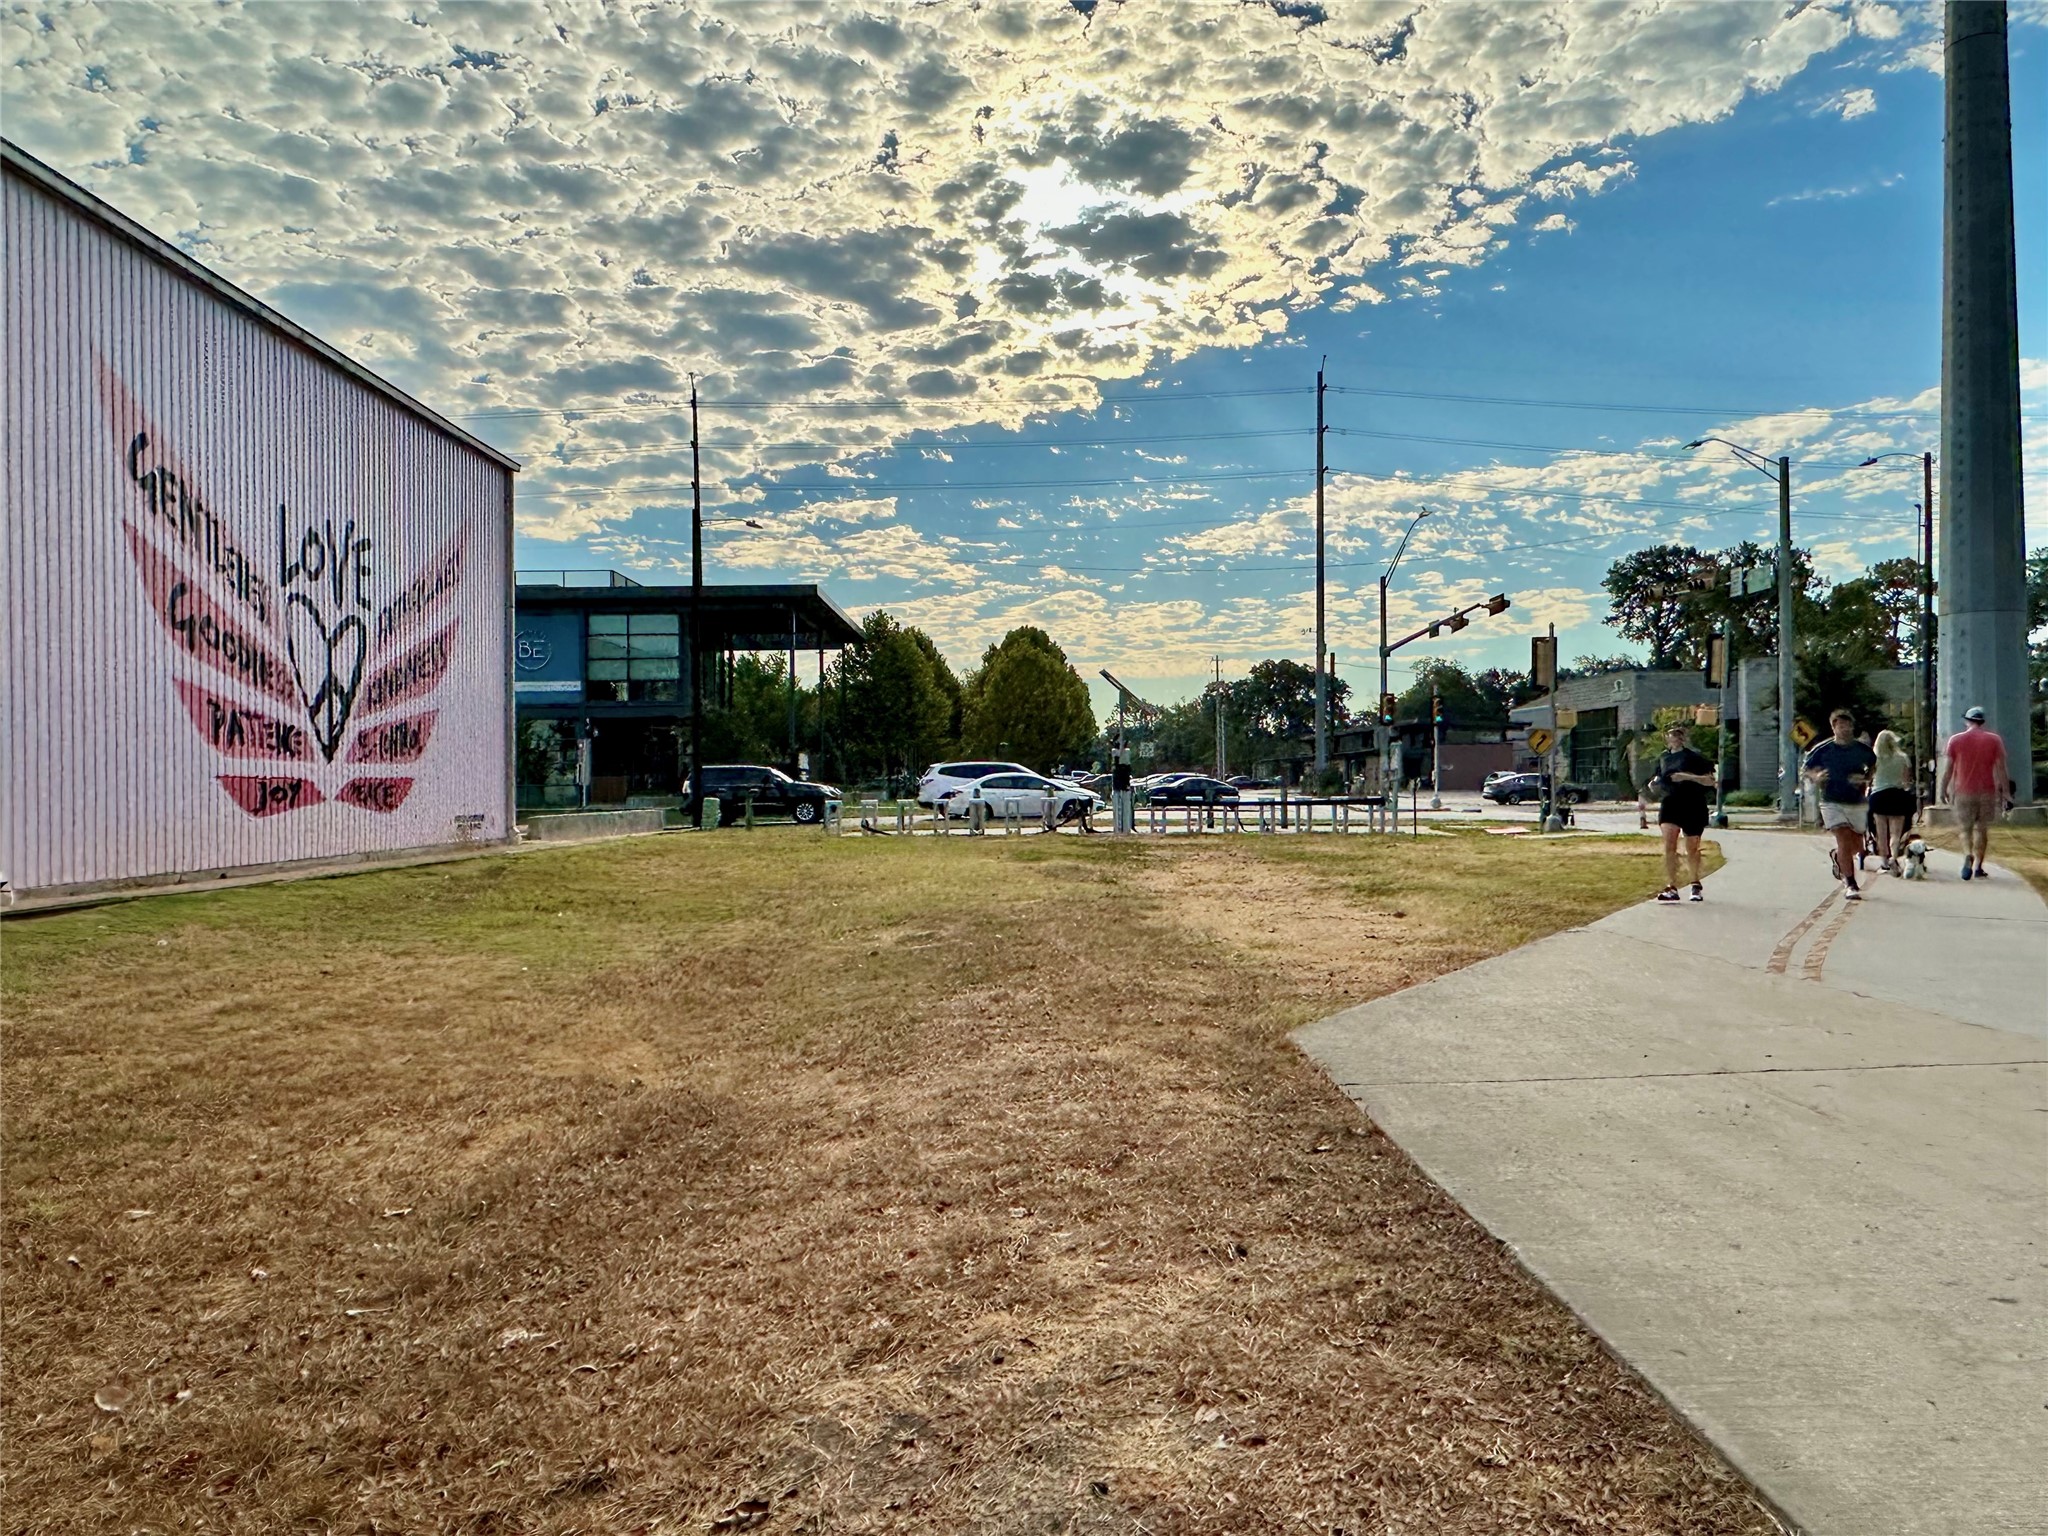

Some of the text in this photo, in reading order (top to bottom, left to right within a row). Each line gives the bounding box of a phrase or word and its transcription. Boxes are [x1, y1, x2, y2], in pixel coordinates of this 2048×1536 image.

[279, 503, 371, 611] LOVE
[518, 640, 545, 658] BE
[251, 777, 300, 816] JOY
